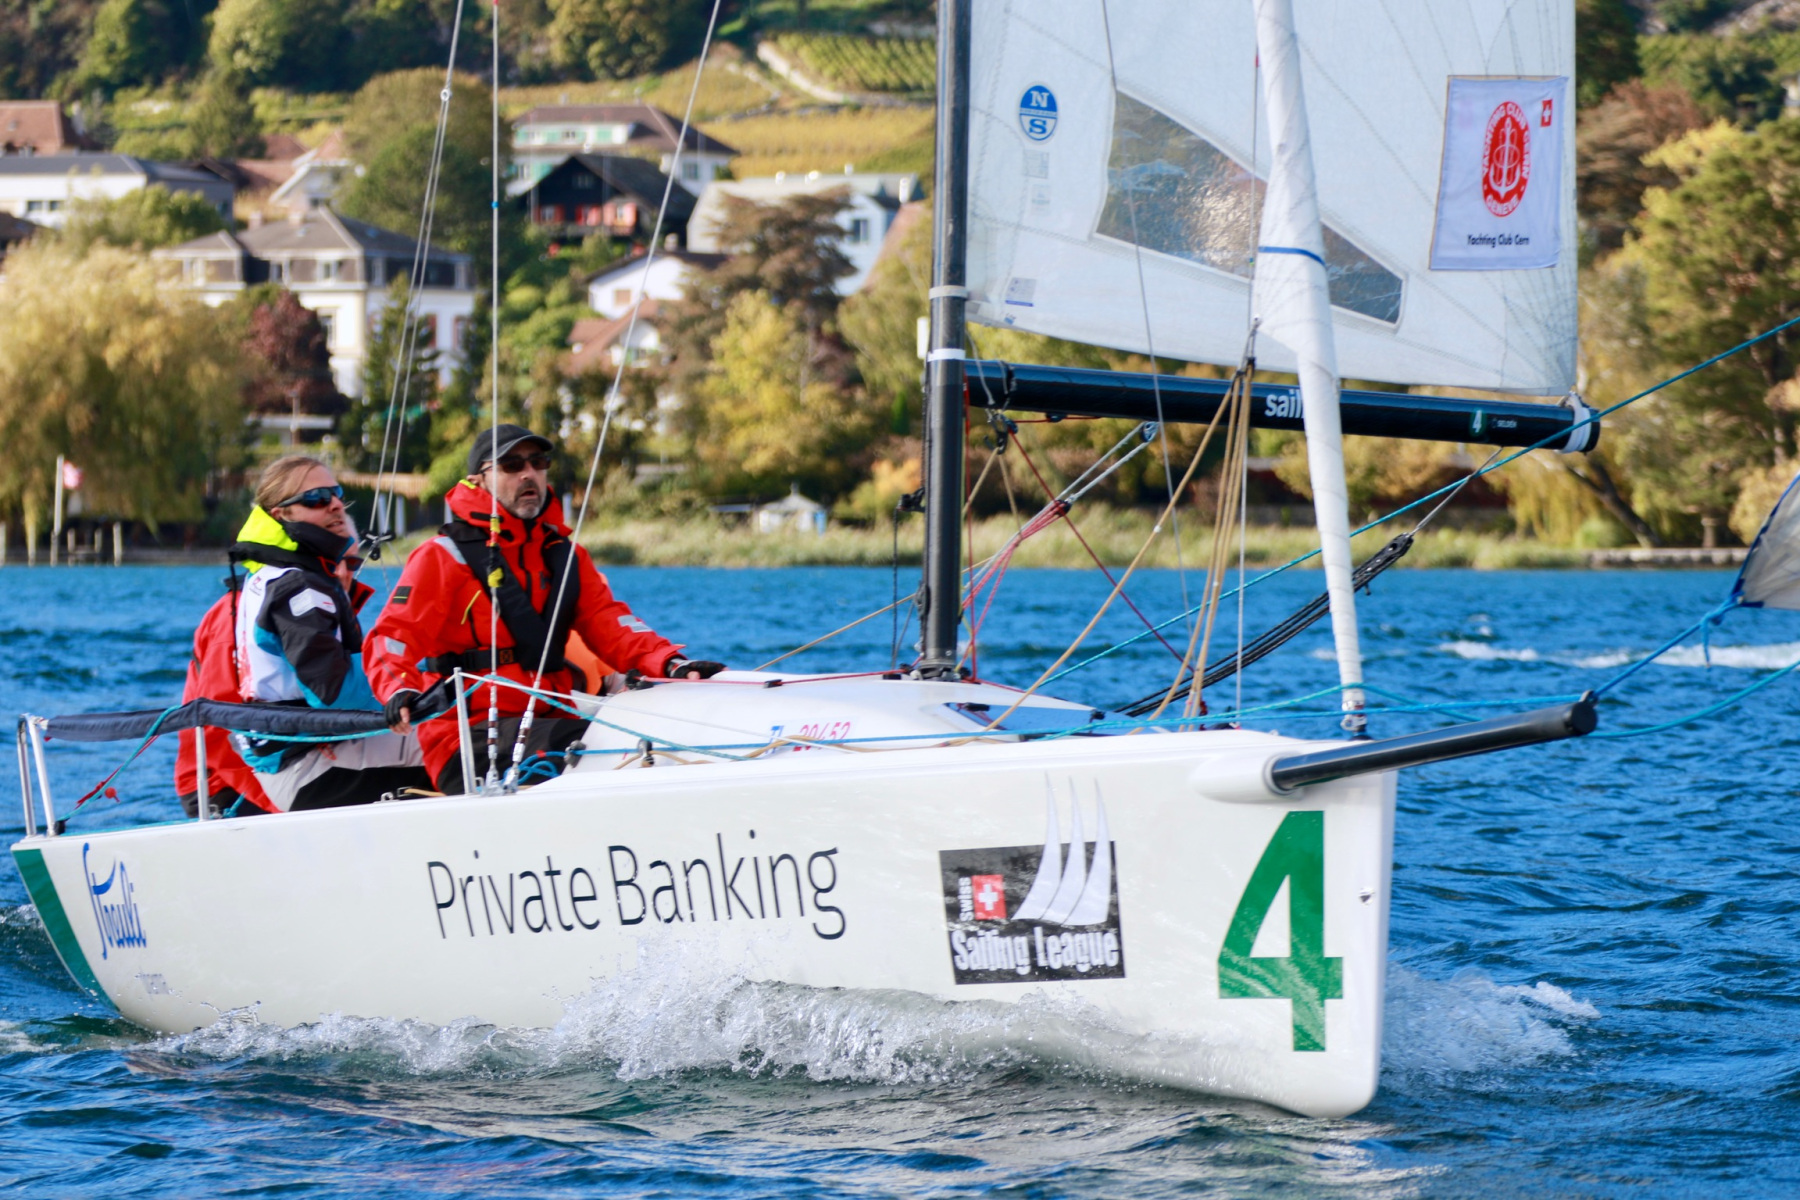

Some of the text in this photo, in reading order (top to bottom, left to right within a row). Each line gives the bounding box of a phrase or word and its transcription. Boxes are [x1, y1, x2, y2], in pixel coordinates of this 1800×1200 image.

[1030, 91, 1049, 108] N
[1029, 118, 1047, 135] S
[1467, 232, 1530, 249] Yachting Club Cern
[1264, 388, 1305, 419] sail
[1471, 409, 1482, 434] 4
[427, 829, 848, 941] Private Banking
[1218, 809, 1344, 1053] 4
[952, 926, 1120, 976] Sailing League
